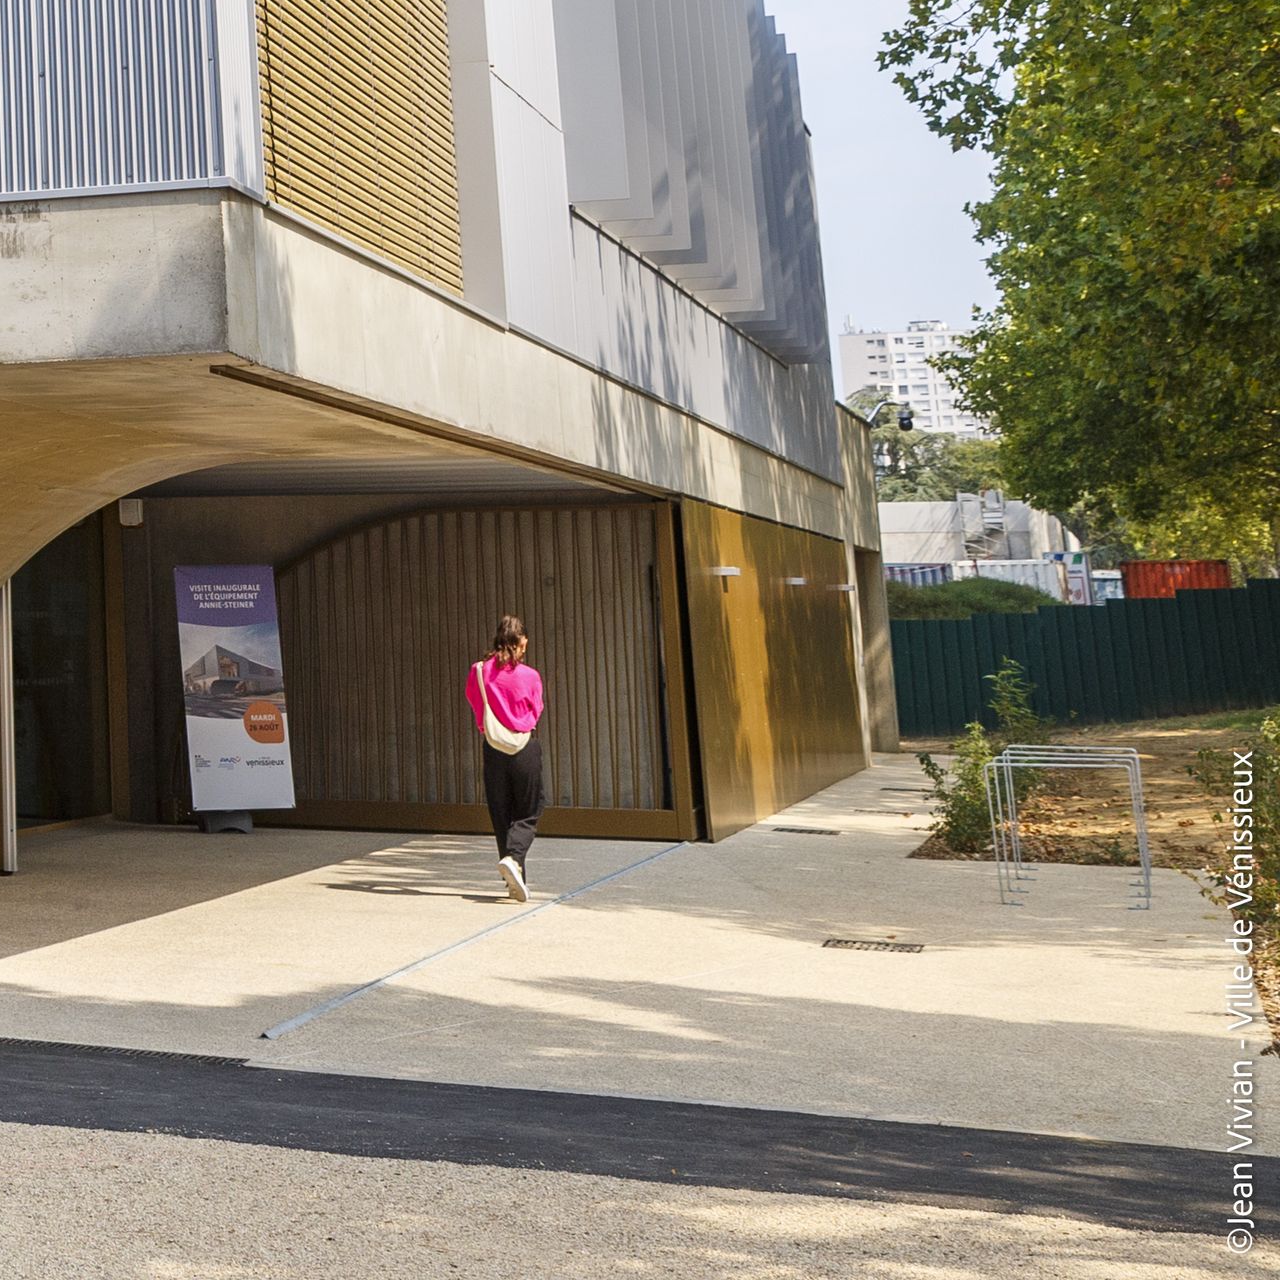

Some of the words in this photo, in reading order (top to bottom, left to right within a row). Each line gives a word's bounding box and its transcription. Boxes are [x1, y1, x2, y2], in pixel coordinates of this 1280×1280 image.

[189, 584, 212, 592] VISITE
[213, 584, 260, 592] INAUGURALE
[199, 601, 255, 609] ANNIE-STEINER
[259, 722, 280, 731] AOÛT
